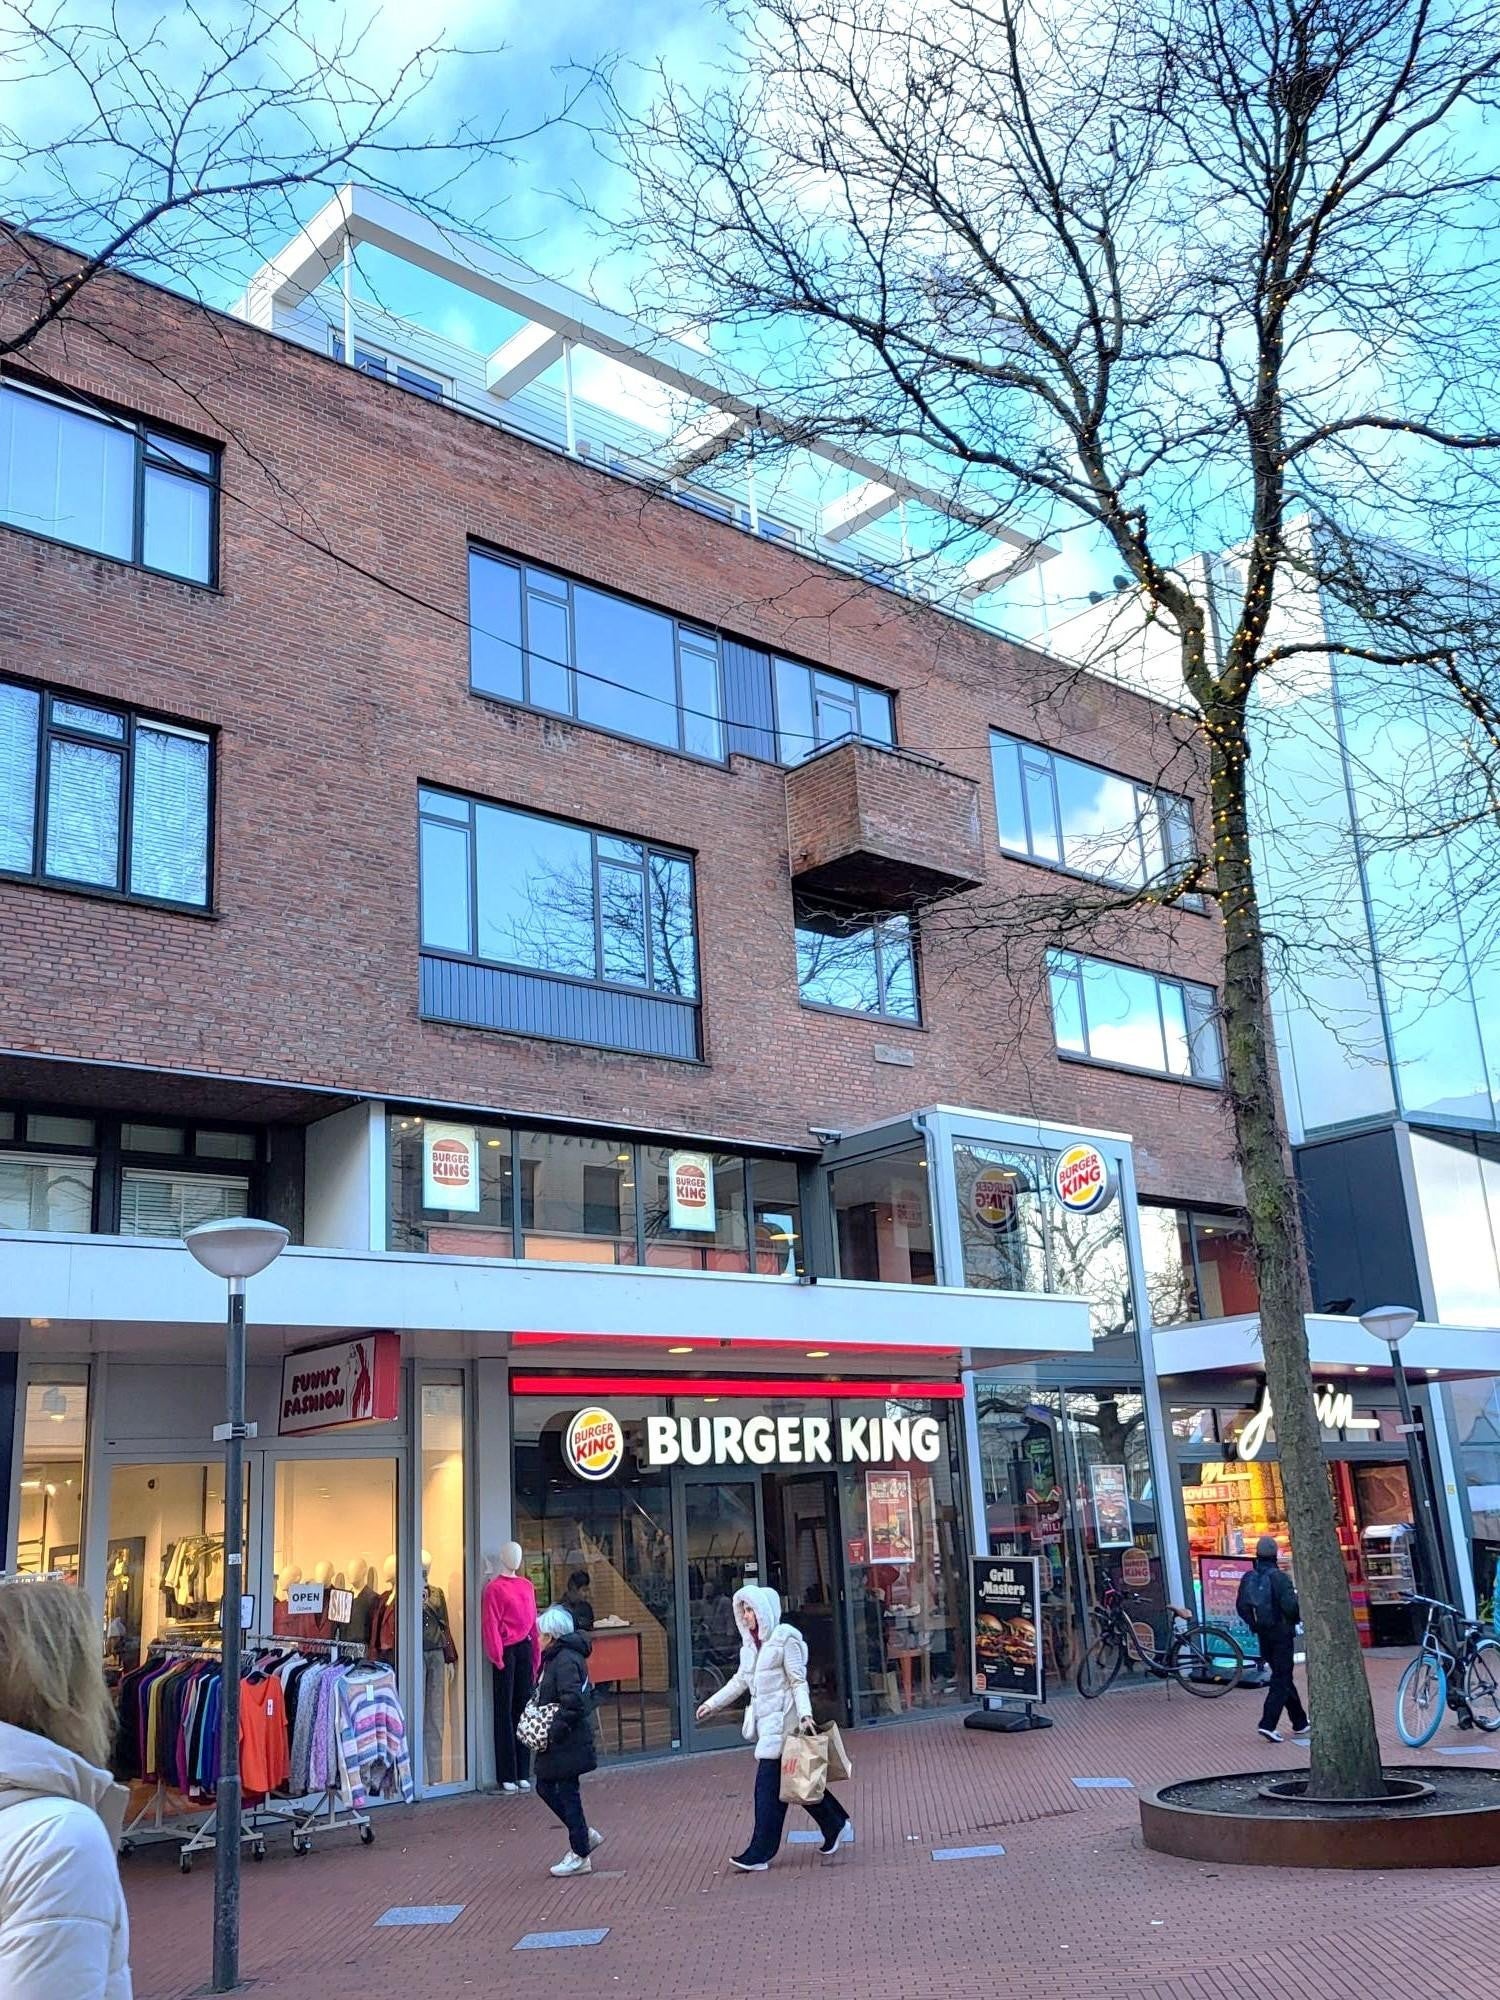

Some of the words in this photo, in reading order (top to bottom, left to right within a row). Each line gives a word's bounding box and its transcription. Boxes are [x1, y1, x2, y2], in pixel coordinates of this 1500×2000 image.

[432, 1152, 470, 1164] BURGER
[432, 1162, 470, 1177] KING
[1059, 1154, 1098, 1183] BURGER
[675, 1177, 706, 1188] BURGER
[1062, 1165, 1101, 1200] KING
[676, 1186, 706, 1199] KING
[292, 1366, 340, 1395] FUNNY
[283, 1388, 345, 1418] FASHION
[574, 1422, 614, 1445] BURGER
[647, 1415, 832, 1465] BURGER
[840, 1416, 940, 1463] KING
[576, 1434, 616, 1463] KING
[989, 1568, 1015, 1583] Grill
[1124, 1567, 1149, 1577] KING
[292, 1592, 320, 1602] OPEN
[979, 1581, 1026, 1597] Masters
